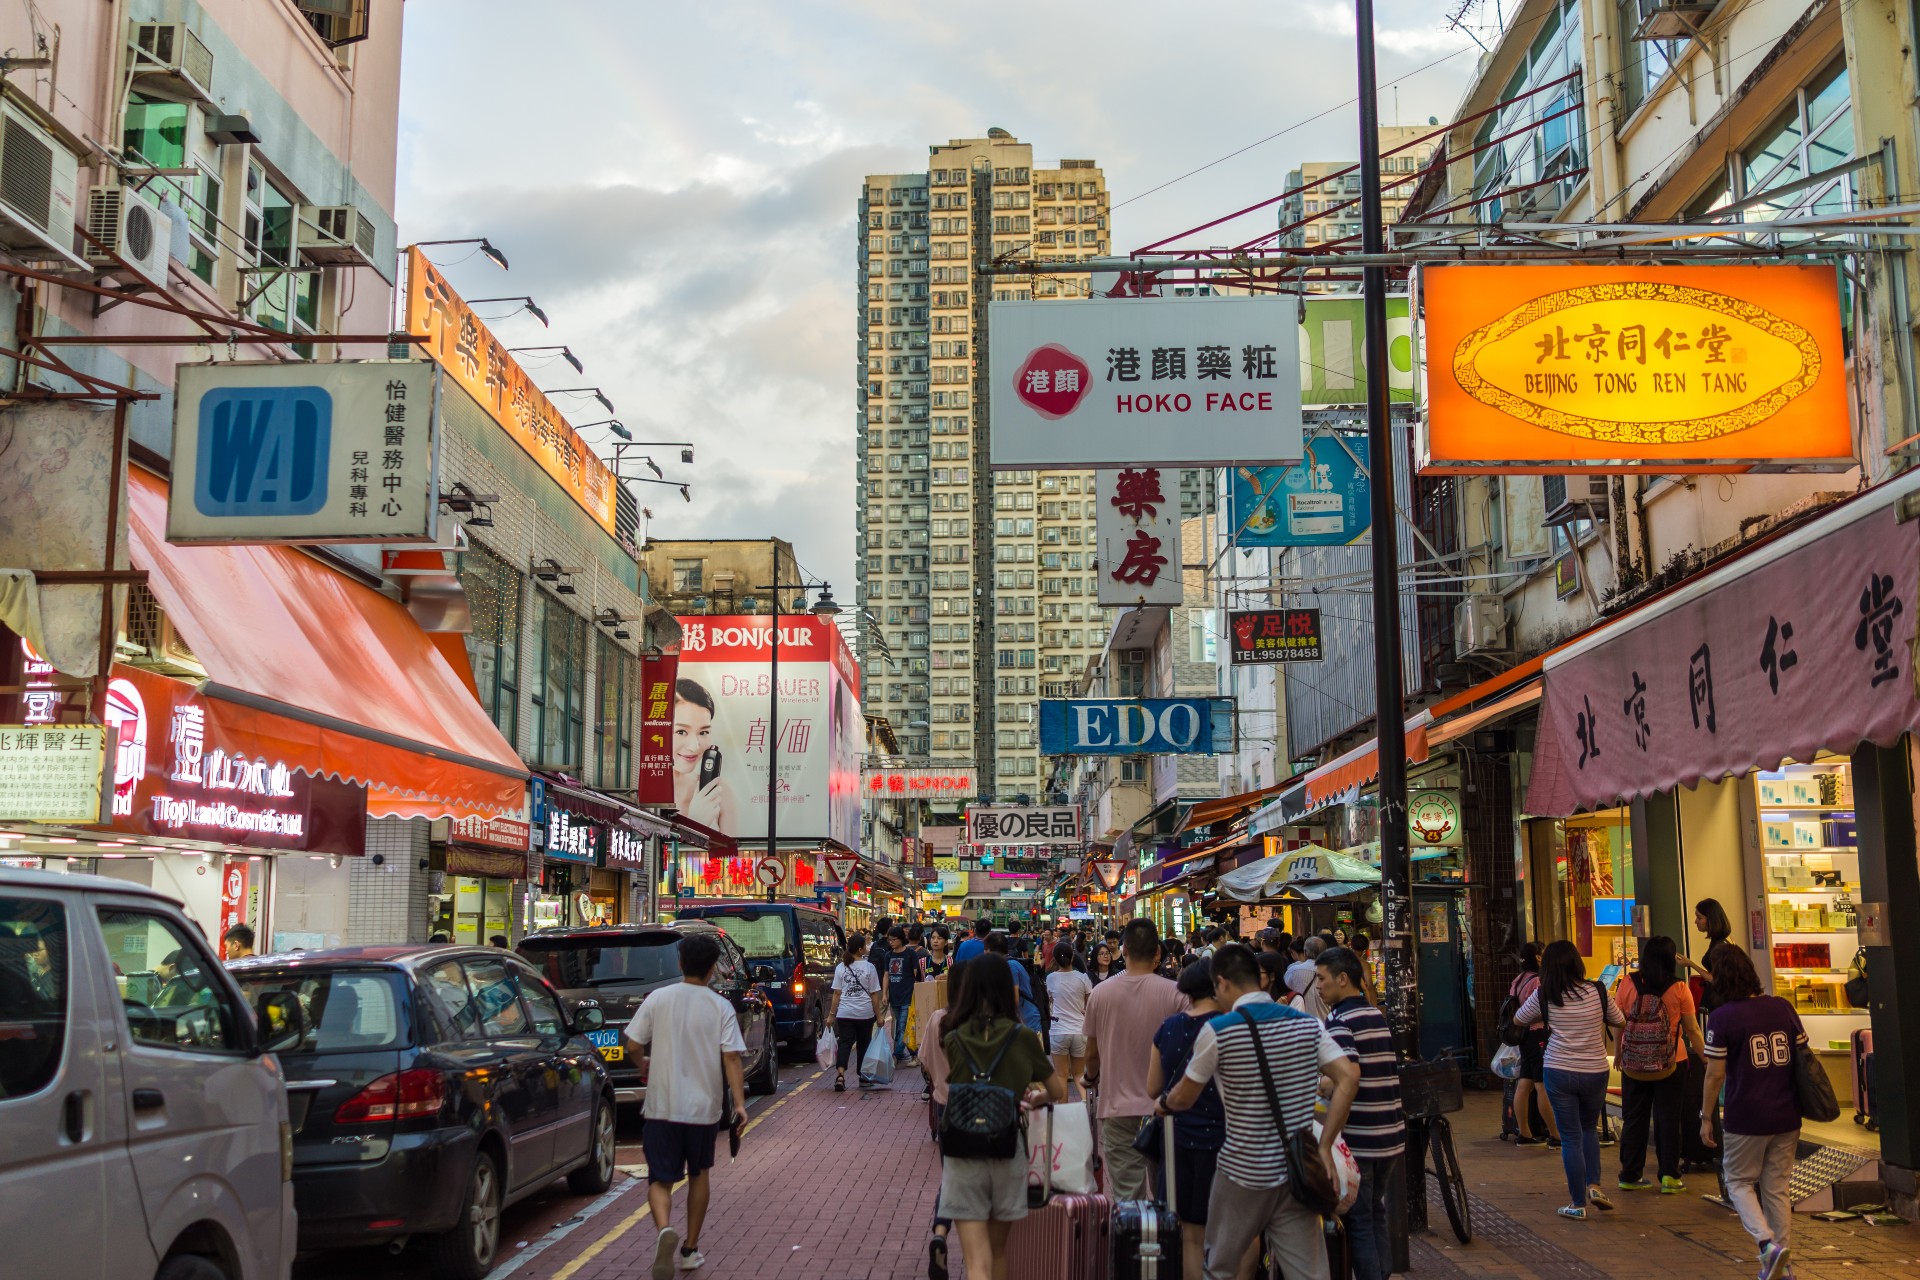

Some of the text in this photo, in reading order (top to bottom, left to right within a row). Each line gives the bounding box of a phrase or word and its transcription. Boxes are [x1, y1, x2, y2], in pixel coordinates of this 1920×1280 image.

[1535, 323, 1732, 365] 北京同仁堂
[1524, 372, 1747, 397] BEIJING TONG REN TANG
[1117, 392, 1273, 413] HOKO FACE
[381, 379, 407, 517] 怡健醫務中心
[349, 450, 369, 518] 兒科專科
[1111, 469, 1168, 586] 藥房
[711, 628, 813, 649] BONJOUR
[1236, 648, 1319, 660] TEL:95878458
[1256, 636, 1317, 648] 美容保健推拿
[1577, 572, 1903, 770] 北京同仁堂
[648, 682, 669, 718] 惠康
[1072, 703, 1200, 747] EDO
[535, 782, 542, 817] P
[909, 776, 970, 792] BONJOUR
[154, 796, 188, 828] Top
[190, 801, 226, 827] Land
[1410, 796, 1454, 815] PO LING
[973, 812, 1076, 839] 優の良品
[1749, 1031, 1790, 1068] 66
[331, 1133, 376, 1145] PICNIC
